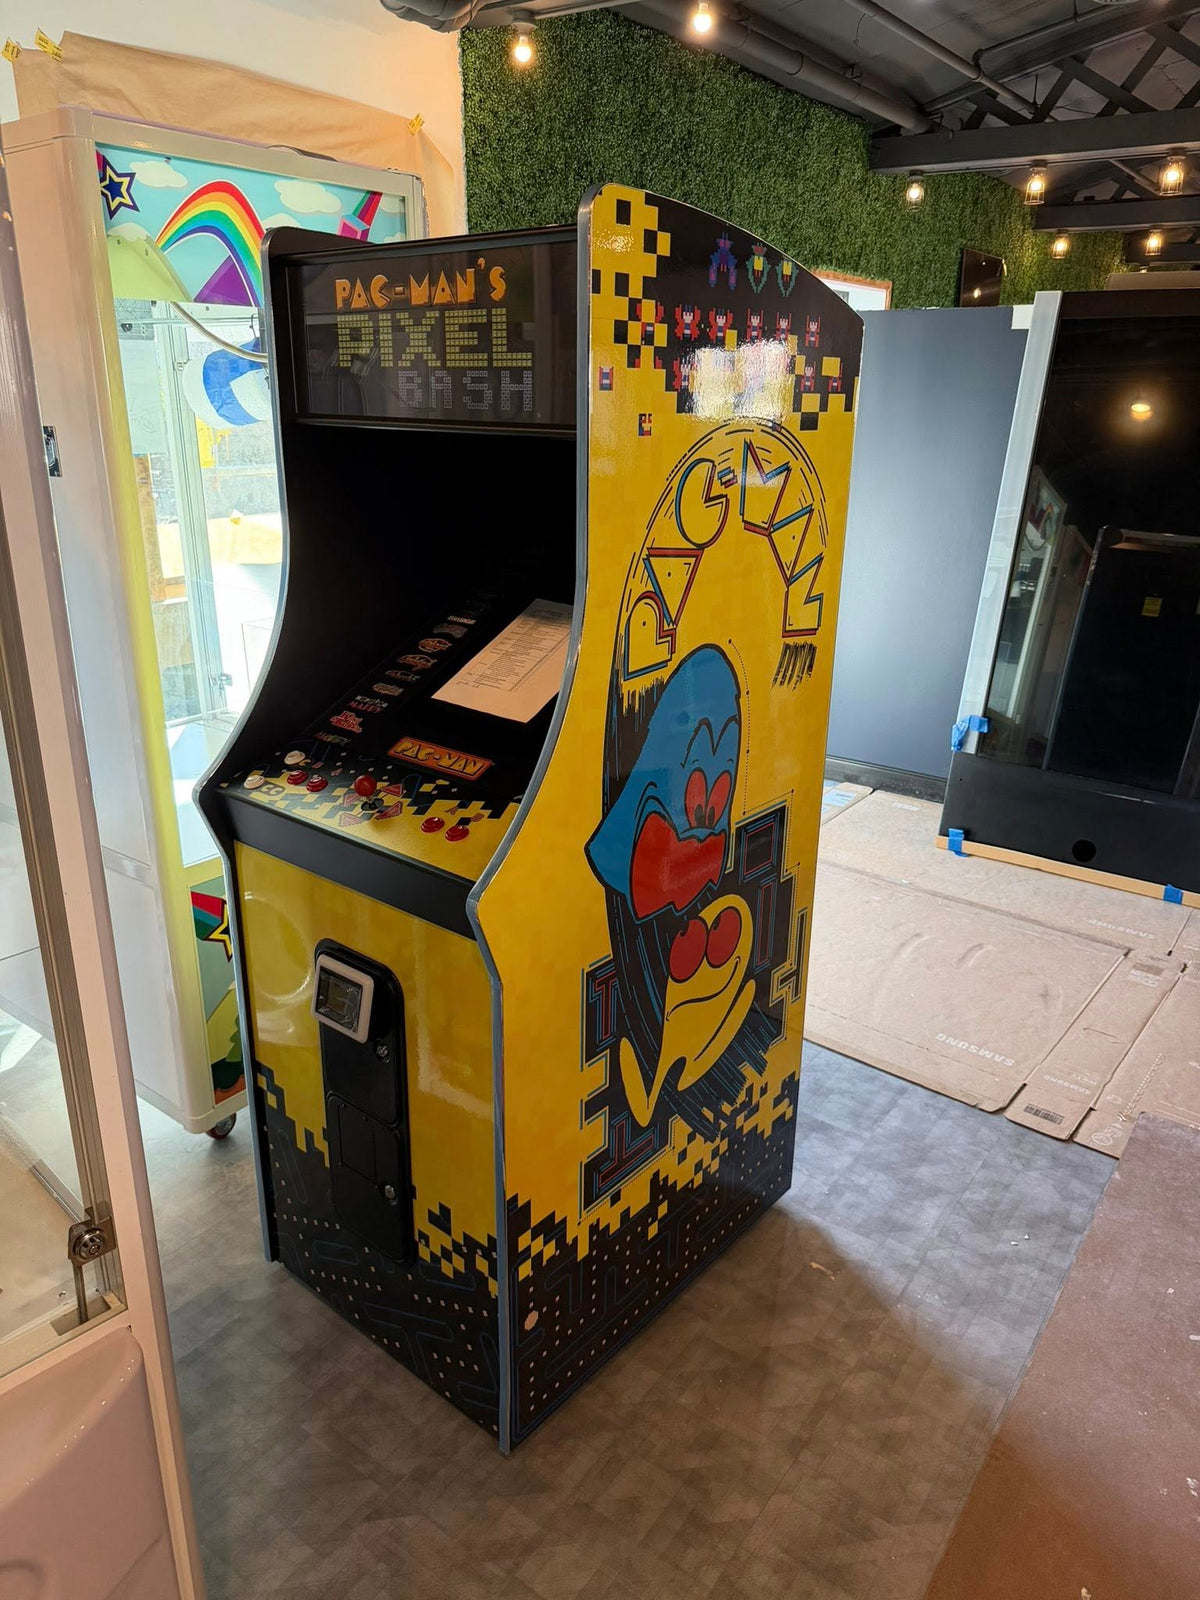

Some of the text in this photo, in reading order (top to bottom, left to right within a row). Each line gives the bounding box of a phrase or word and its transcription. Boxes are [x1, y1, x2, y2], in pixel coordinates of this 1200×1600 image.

[335, 257, 508, 311] PAC-MAN'S
[336, 307, 533, 368] PIXEL
[397, 370, 533, 411] BASH
[394, 741, 484, 777] PAC-MAN
[935, 1033, 1015, 1067] SAMSUNG
